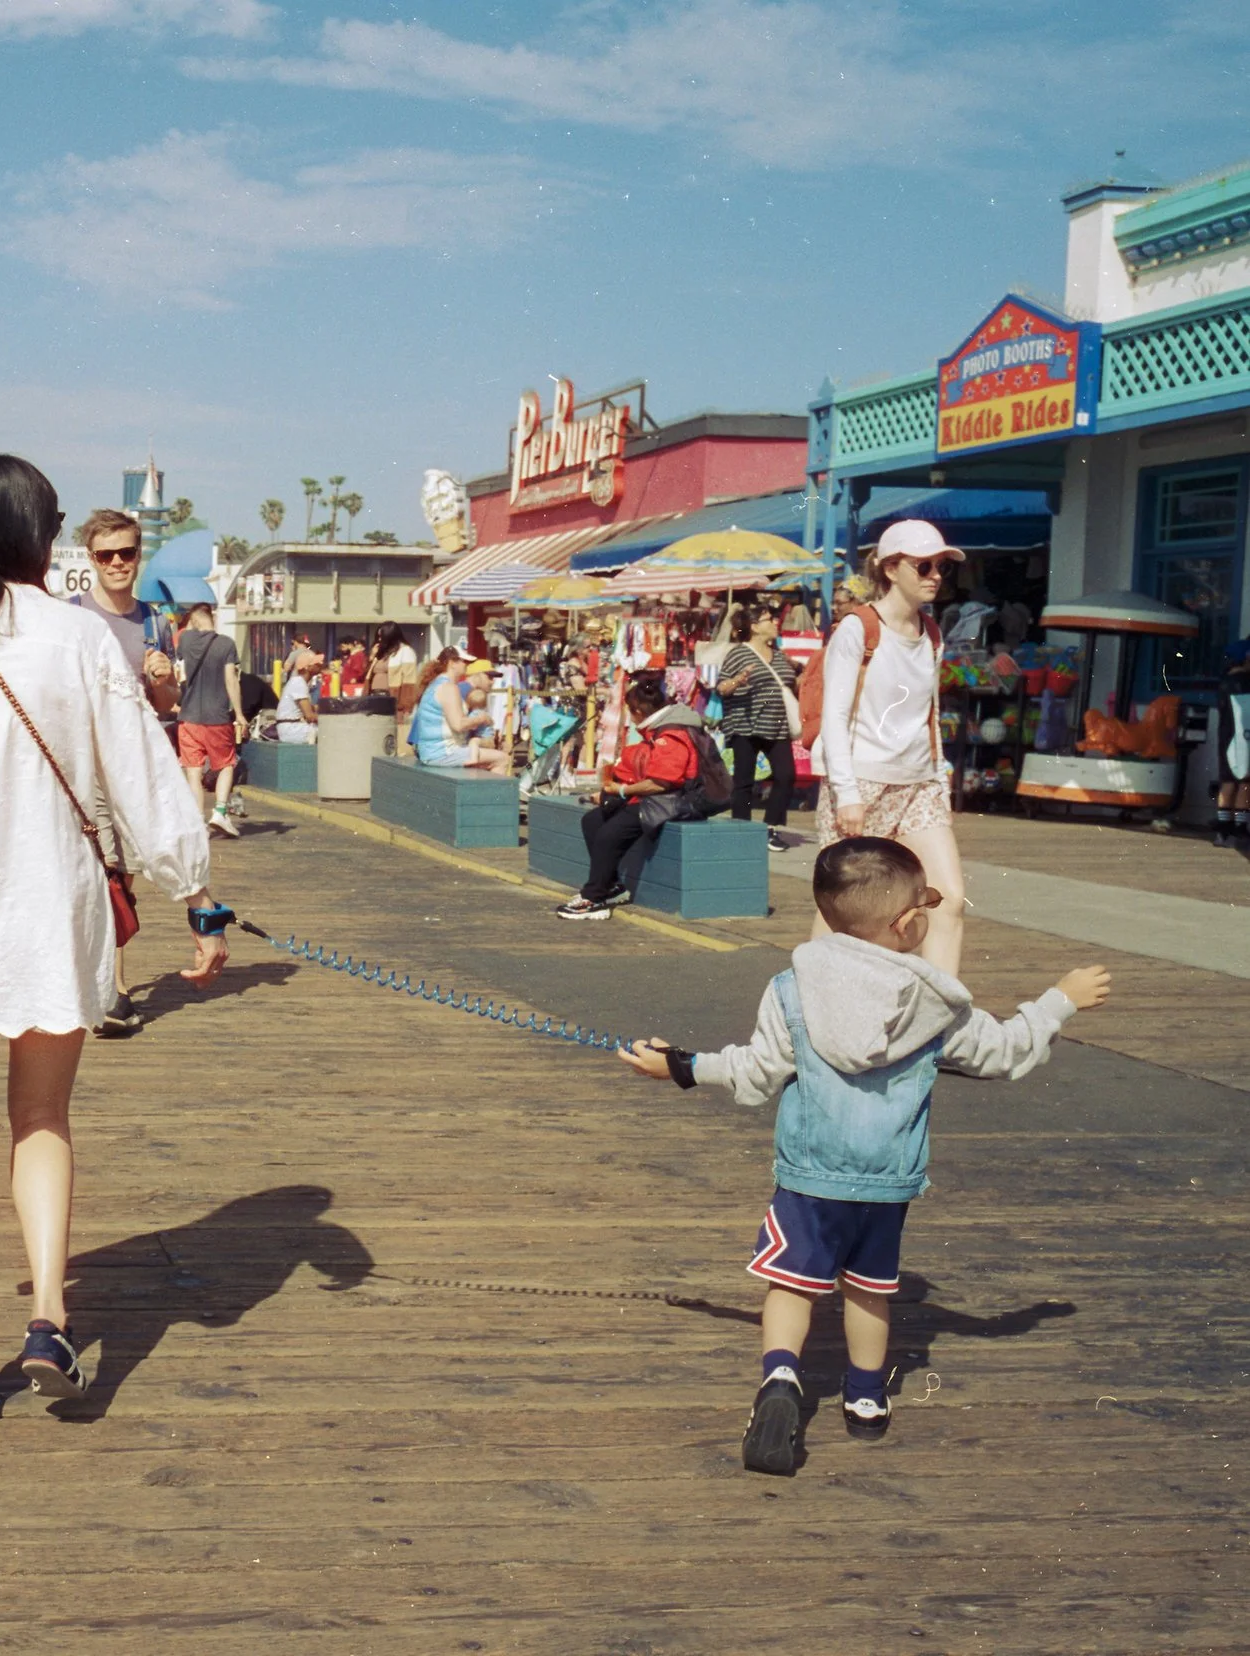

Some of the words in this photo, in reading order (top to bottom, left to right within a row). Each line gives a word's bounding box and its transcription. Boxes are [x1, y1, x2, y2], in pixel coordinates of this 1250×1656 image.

[962, 350, 1000, 379] PHOTO
[1003, 338, 1054, 366] BOOTHS
[940, 407, 1003, 447] Kiddie
[1011, 395, 1071, 434] Rides
[65, 568, 91, 592] 66
